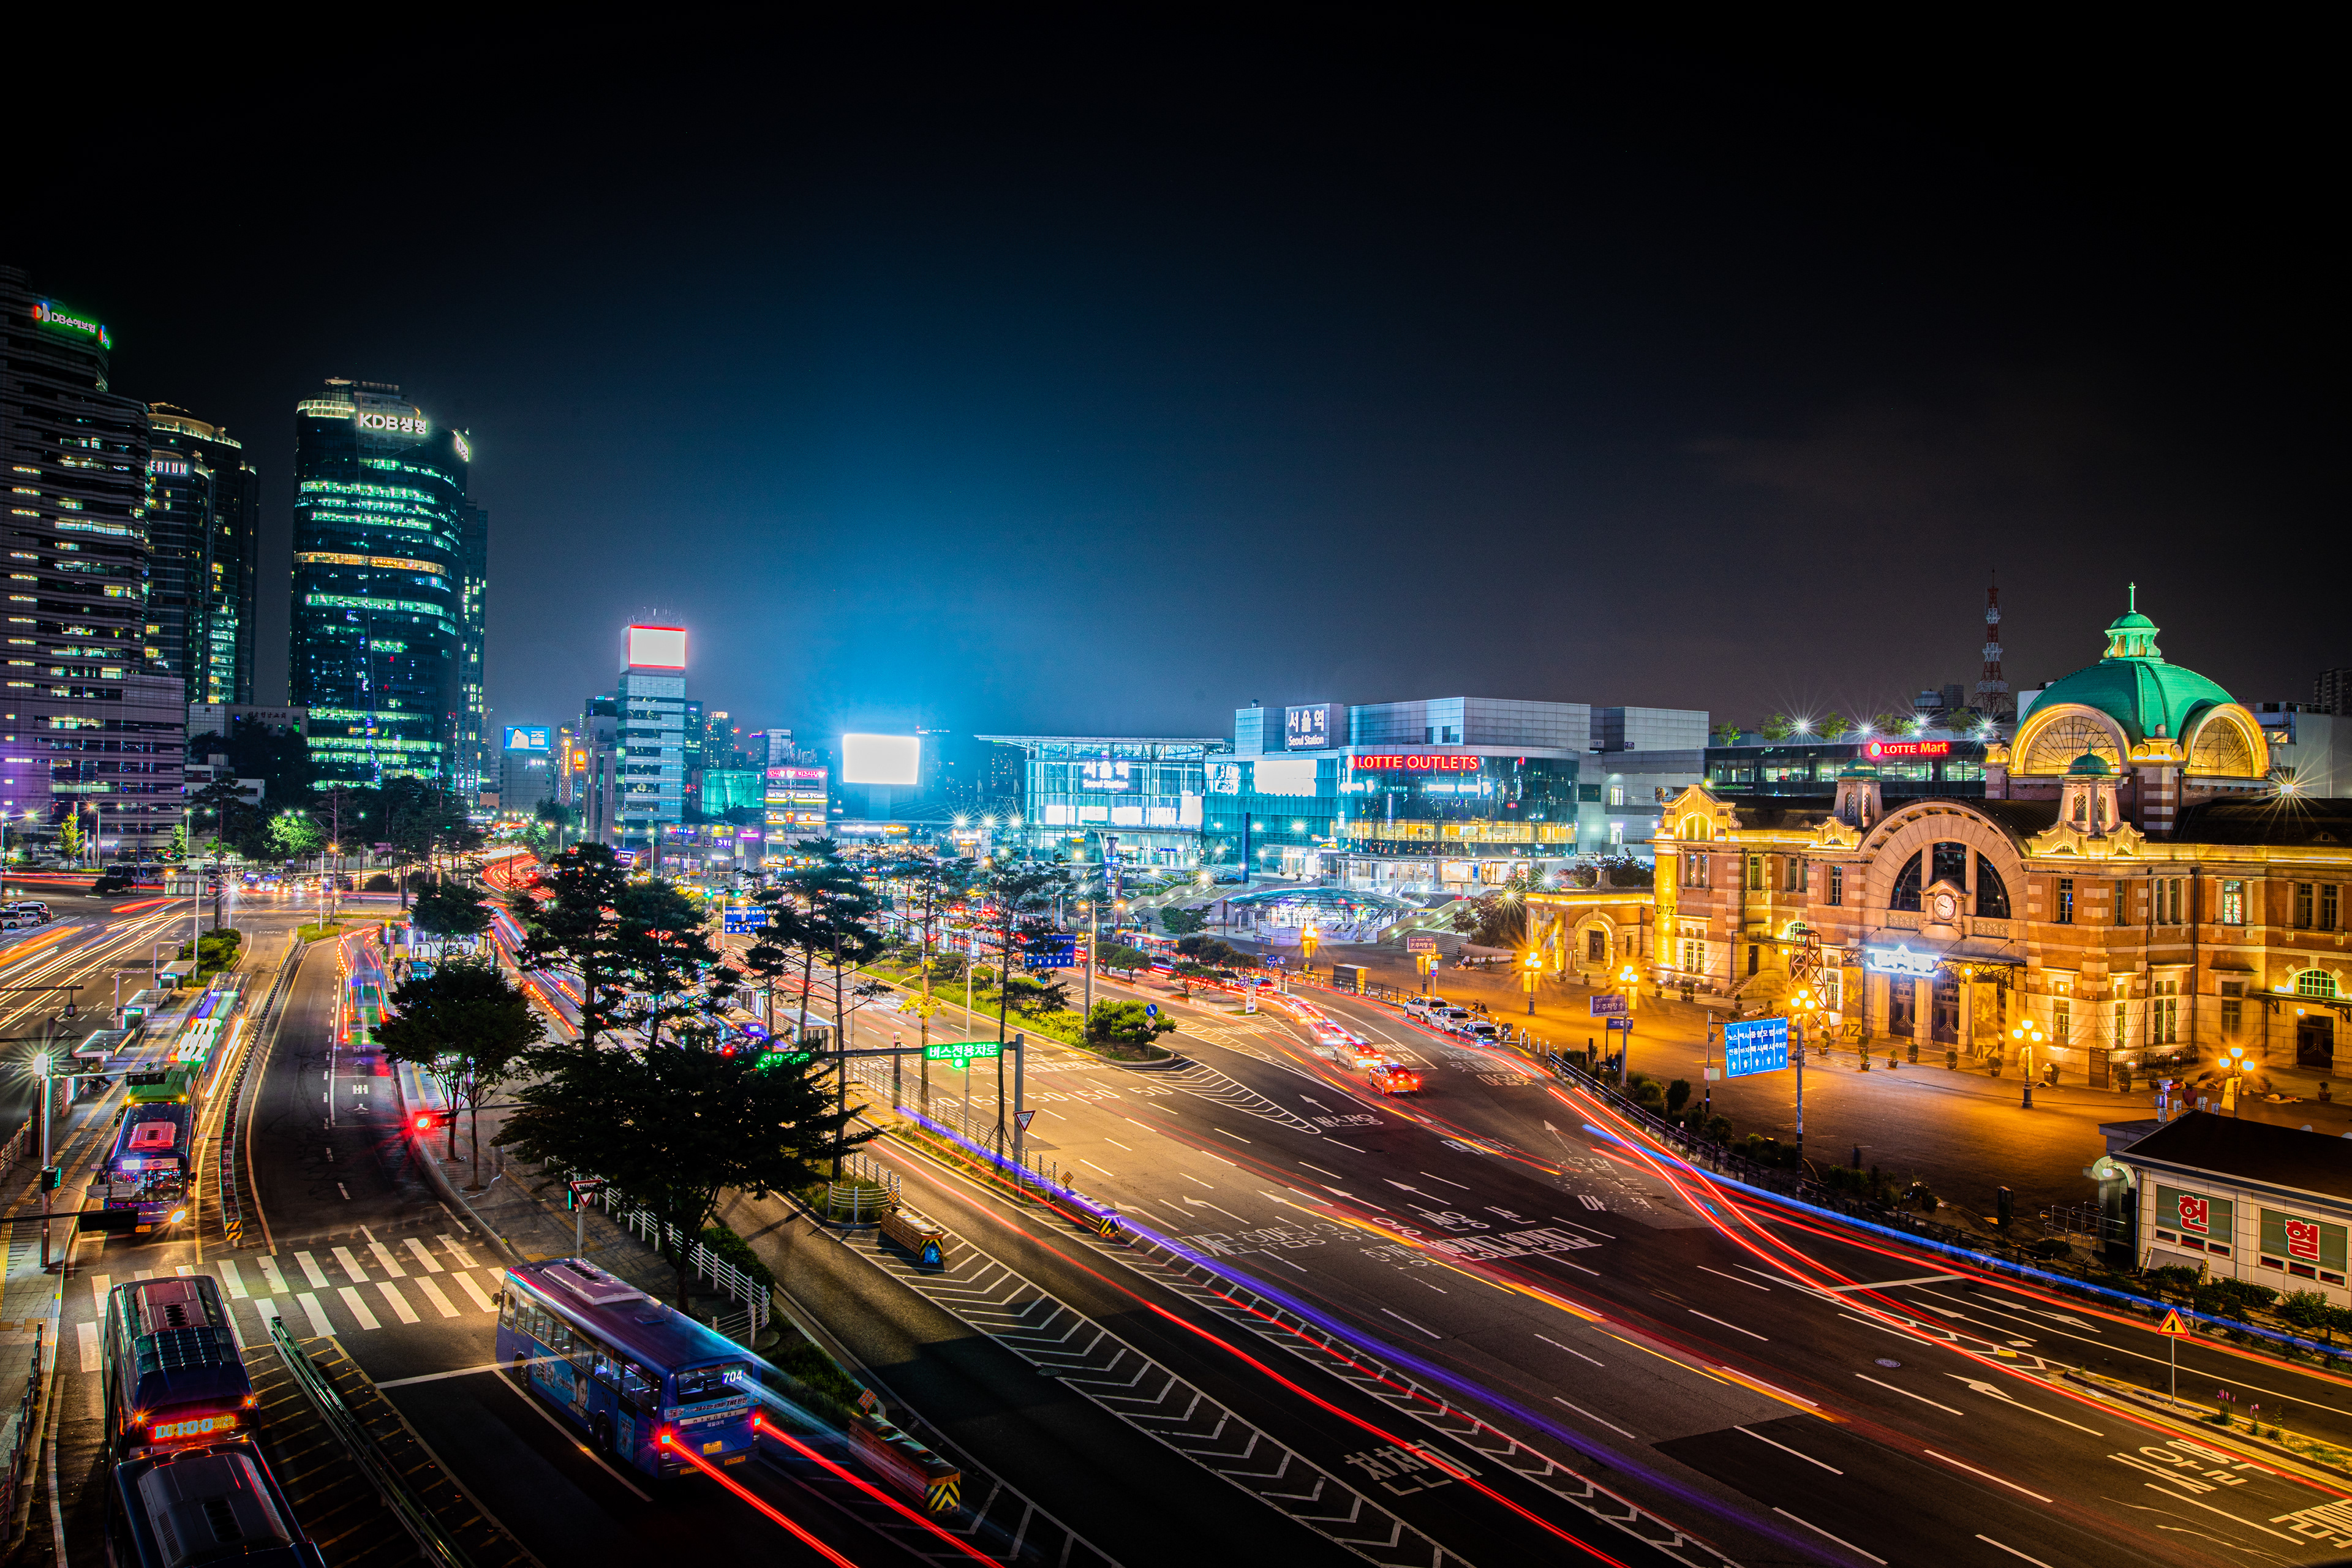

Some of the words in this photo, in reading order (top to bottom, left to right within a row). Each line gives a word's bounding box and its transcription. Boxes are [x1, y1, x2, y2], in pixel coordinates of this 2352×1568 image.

[51, 312, 96, 333] DB손해보험
[360, 413, 428, 435] KDB생명
[1288, 709, 1325, 733] 서울역
[1288, 735, 1304, 746] Seoul
[1304, 734, 1324, 745] Station
[1884, 745, 1917, 754] LOTTE
[1920, 742, 1947, 753] Mart
[1083, 761, 1129, 778] 서울역
[1358, 756, 1403, 768] LOTTE
[1407, 756, 1478, 769] OUTLETS
[1083, 779, 1103, 788] Seoul
[1103, 780, 1129, 789] Station
[1656, 905, 1675, 916] DMZ
[929, 1043, 998, 1058] 버스전용차로
[1023, 1092, 1069, 1102] 50
[1076, 1090, 1120, 1100] 50
[1128, 1085, 1174, 1096] 50
[1311, 1114, 1384, 1127] 버스전용
[2178, 1195, 2209, 1235] 헌
[2285, 1219, 2320, 1262] 혈
[1498, 1227, 1603, 1253] 한강대교
[1428, 1235, 1535, 1262] 한강대교
[723, 1370, 743, 1384] 704
[601, 1391, 611, 1408] 704
[1344, 1439, 1483, 1496] 천천히
[2107, 1439, 2277, 1494] 서울역
